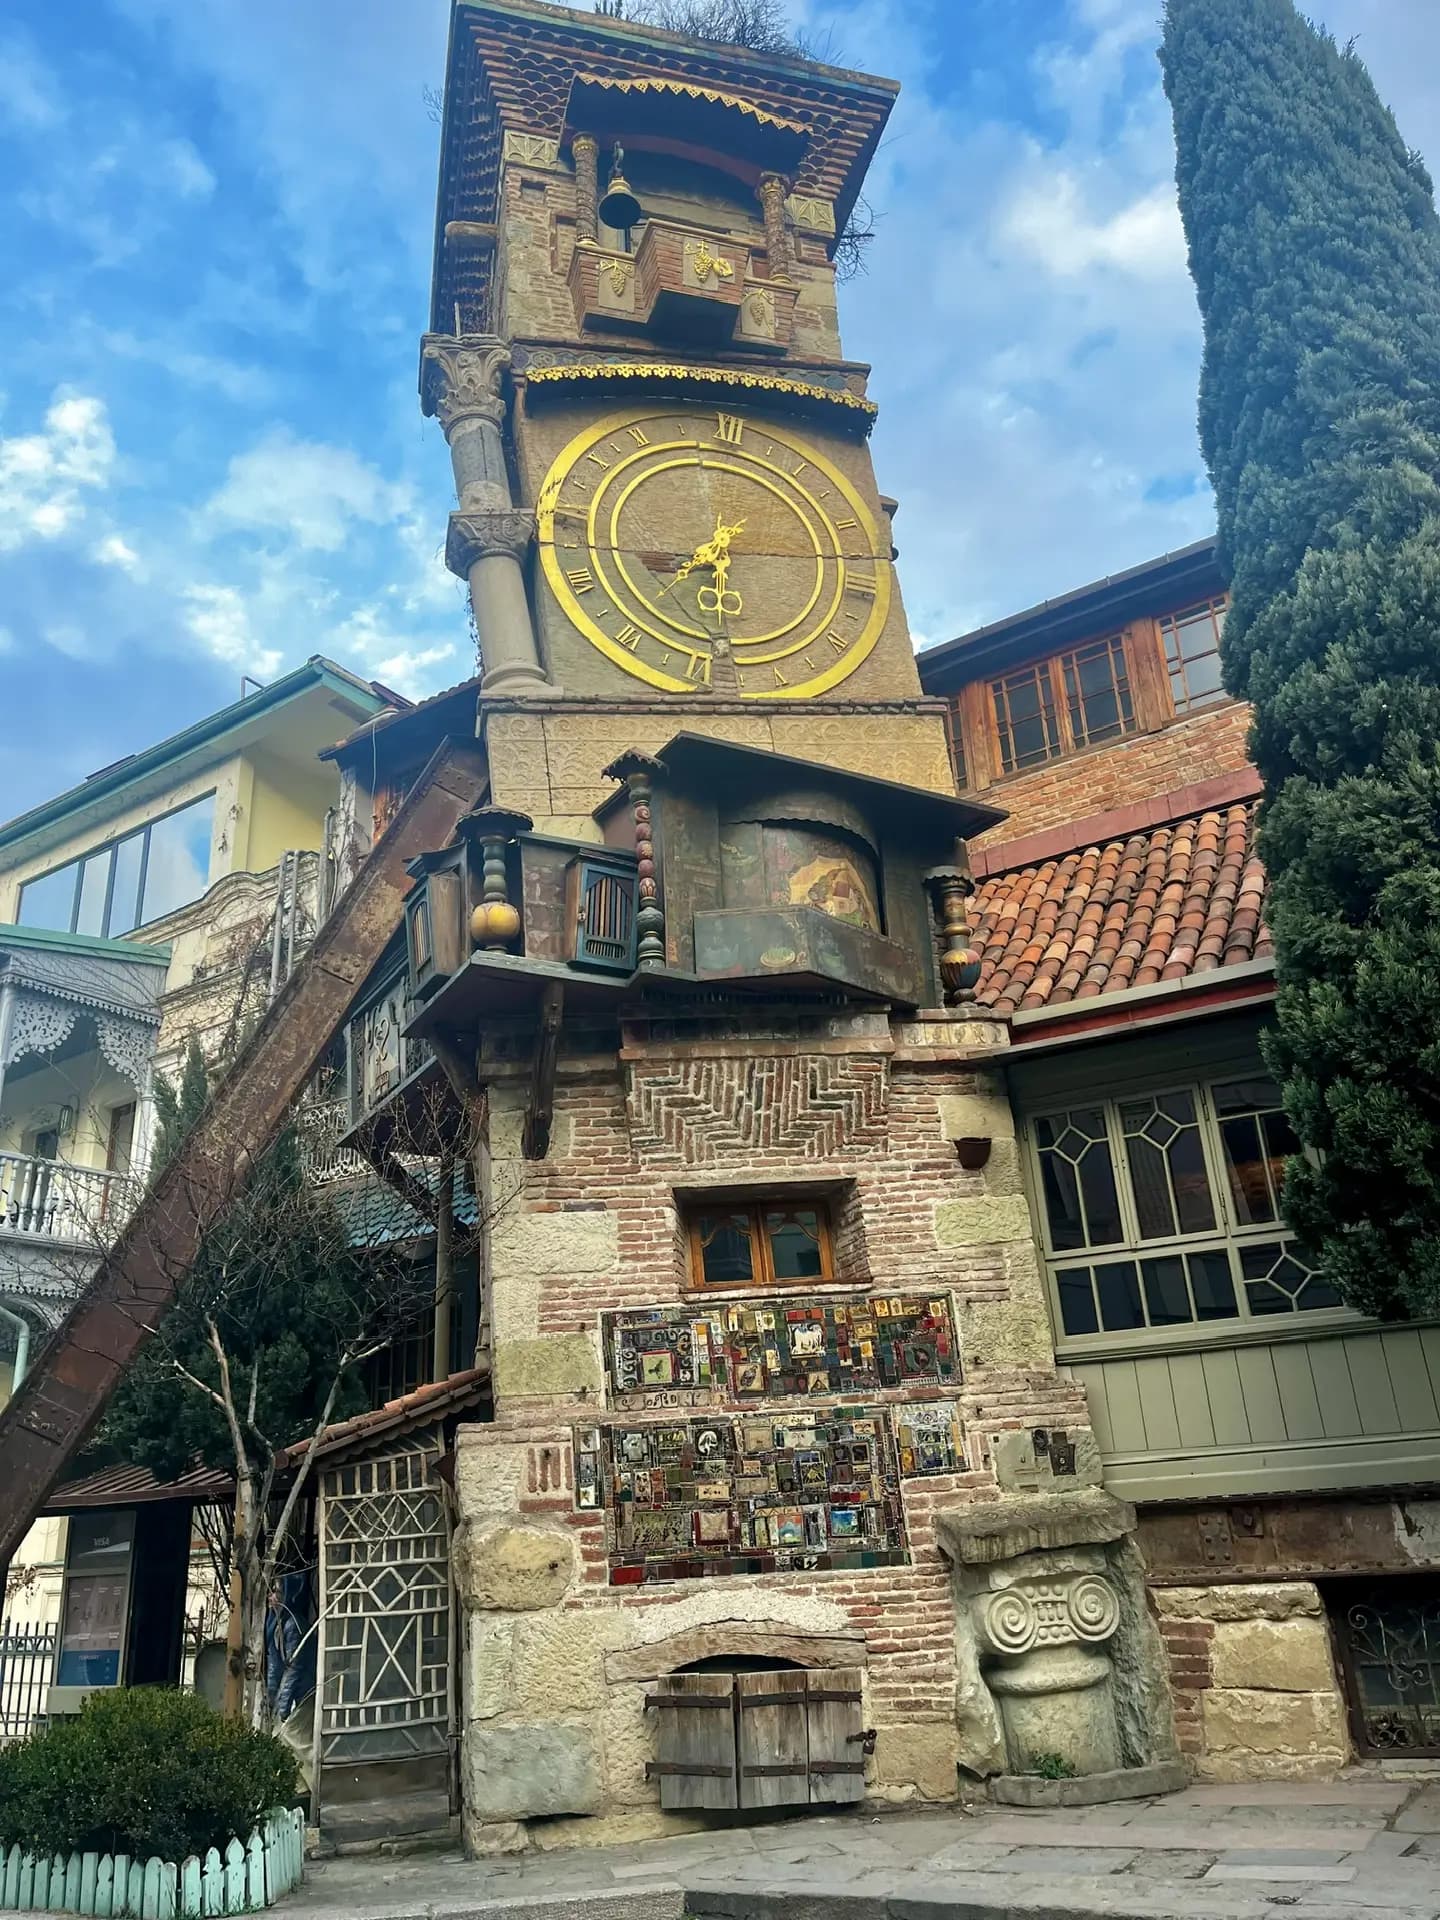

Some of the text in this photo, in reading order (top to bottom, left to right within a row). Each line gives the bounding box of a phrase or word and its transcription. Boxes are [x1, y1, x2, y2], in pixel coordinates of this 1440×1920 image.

[713, 412, 747, 445] XII
[835, 518, 857, 530] II
[566, 567, 596, 595] VIII
[845, 571, 877, 594] III
[614, 623, 643, 653] VII
[773, 665, 790, 687] V
